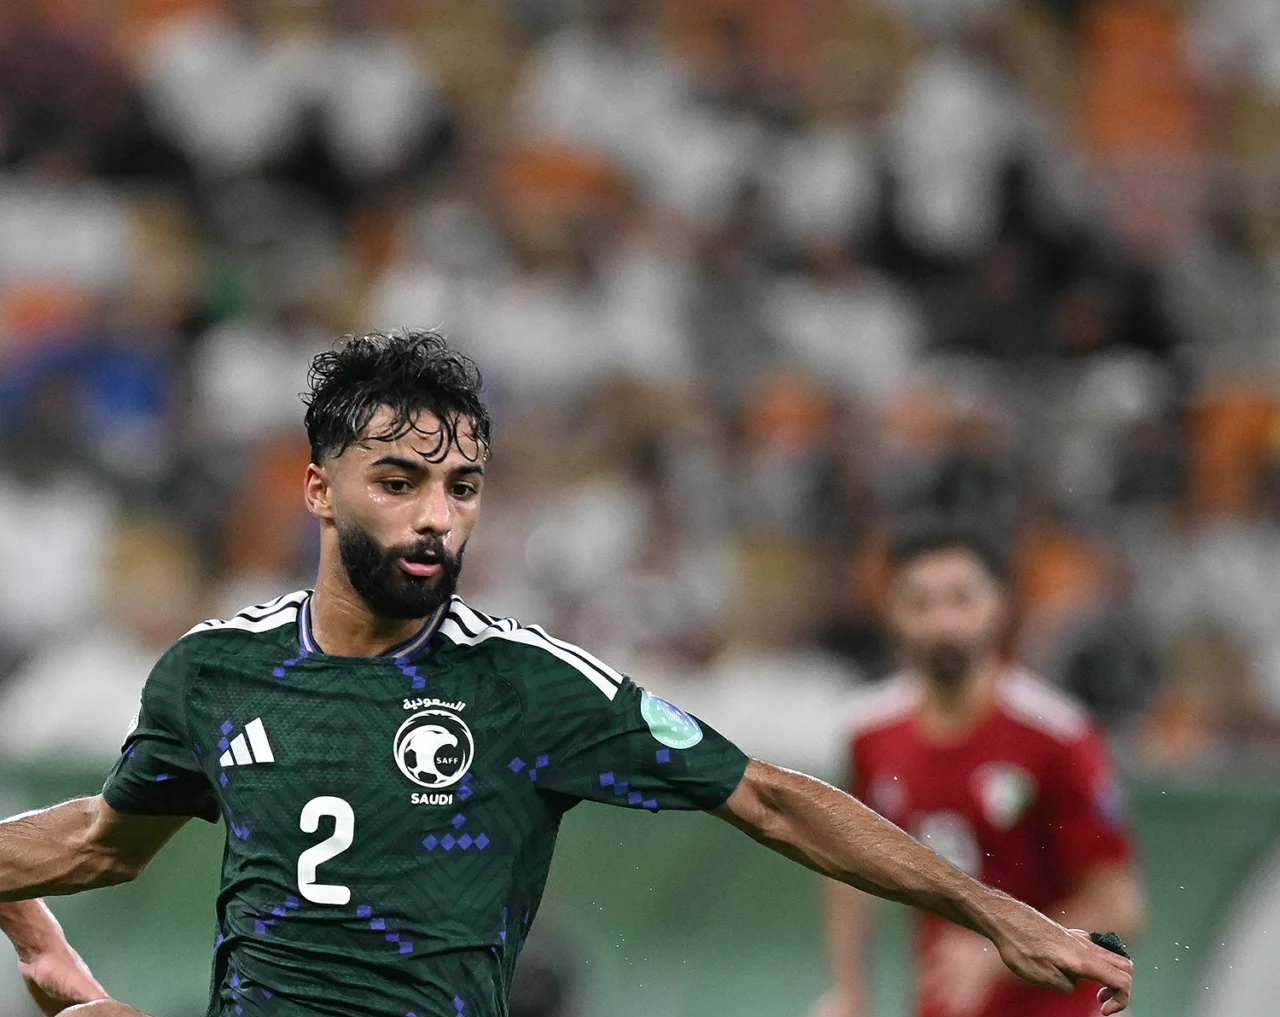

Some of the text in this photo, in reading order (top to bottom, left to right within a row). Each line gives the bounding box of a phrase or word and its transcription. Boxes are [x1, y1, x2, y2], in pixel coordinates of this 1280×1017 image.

[402, 697, 467, 712] السعودية
[436, 757, 459, 765] SAFF
[410, 793, 453, 805] SAUDI
[297, 795, 355, 905] 2
